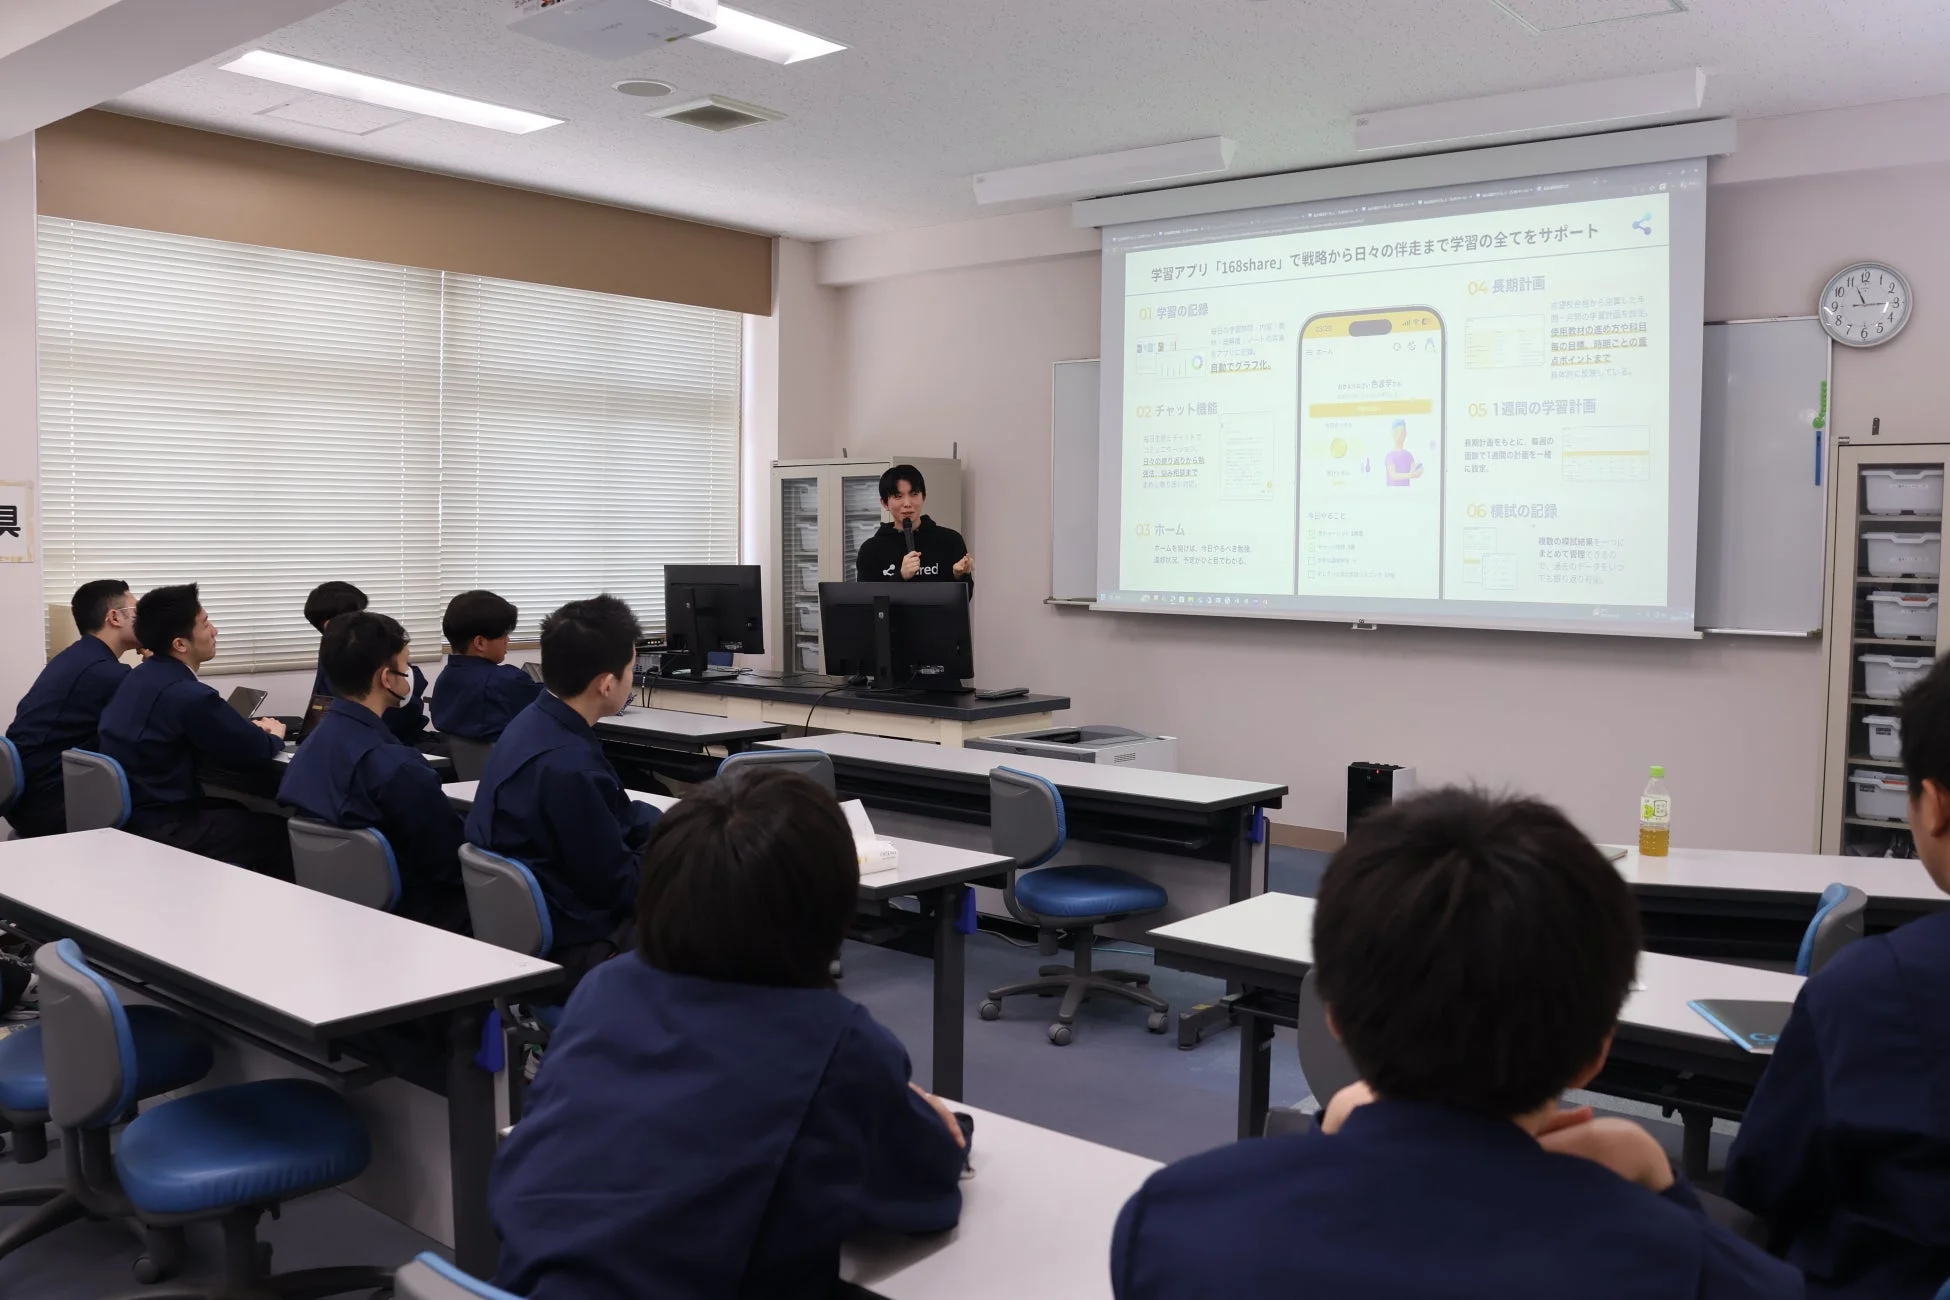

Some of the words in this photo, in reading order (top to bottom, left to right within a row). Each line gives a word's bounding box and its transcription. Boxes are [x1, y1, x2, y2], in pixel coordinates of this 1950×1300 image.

[1847, 275, 1855, 288] 11
[1861, 271, 1871, 283] 12
[1880, 273, 1884, 285] 1
[1467, 281, 1488, 296] 04
[1492, 275, 1546, 294] 長期計画
[1887, 282, 1896, 294] 2
[1835, 286, 1845, 298] 10
[1831, 301, 1838, 312] 9
[1892, 297, 1900, 309] 3
[1139, 308, 1152, 320] 01
[1156, 302, 1209, 320] 学習の記録
[1887, 312, 1894, 322] 4
[1835, 314, 1843, 326] 8
[1846, 324, 1853, 336] 7
[1860, 327, 1868, 339] 6
[1876, 322, 1884, 334] 5
[1136, 405, 1152, 419] 02
[1155, 402, 1218, 418] チャット機能
[1468, 402, 1487, 417] 05
[1493, 398, 1597, 417] 1週間の学習計画
[1466, 503, 1487, 518] 06
[1490, 503, 1558, 520] 模試の記録
[1135, 523, 1151, 537] 03
[1155, 523, 1186, 536] ホーム
